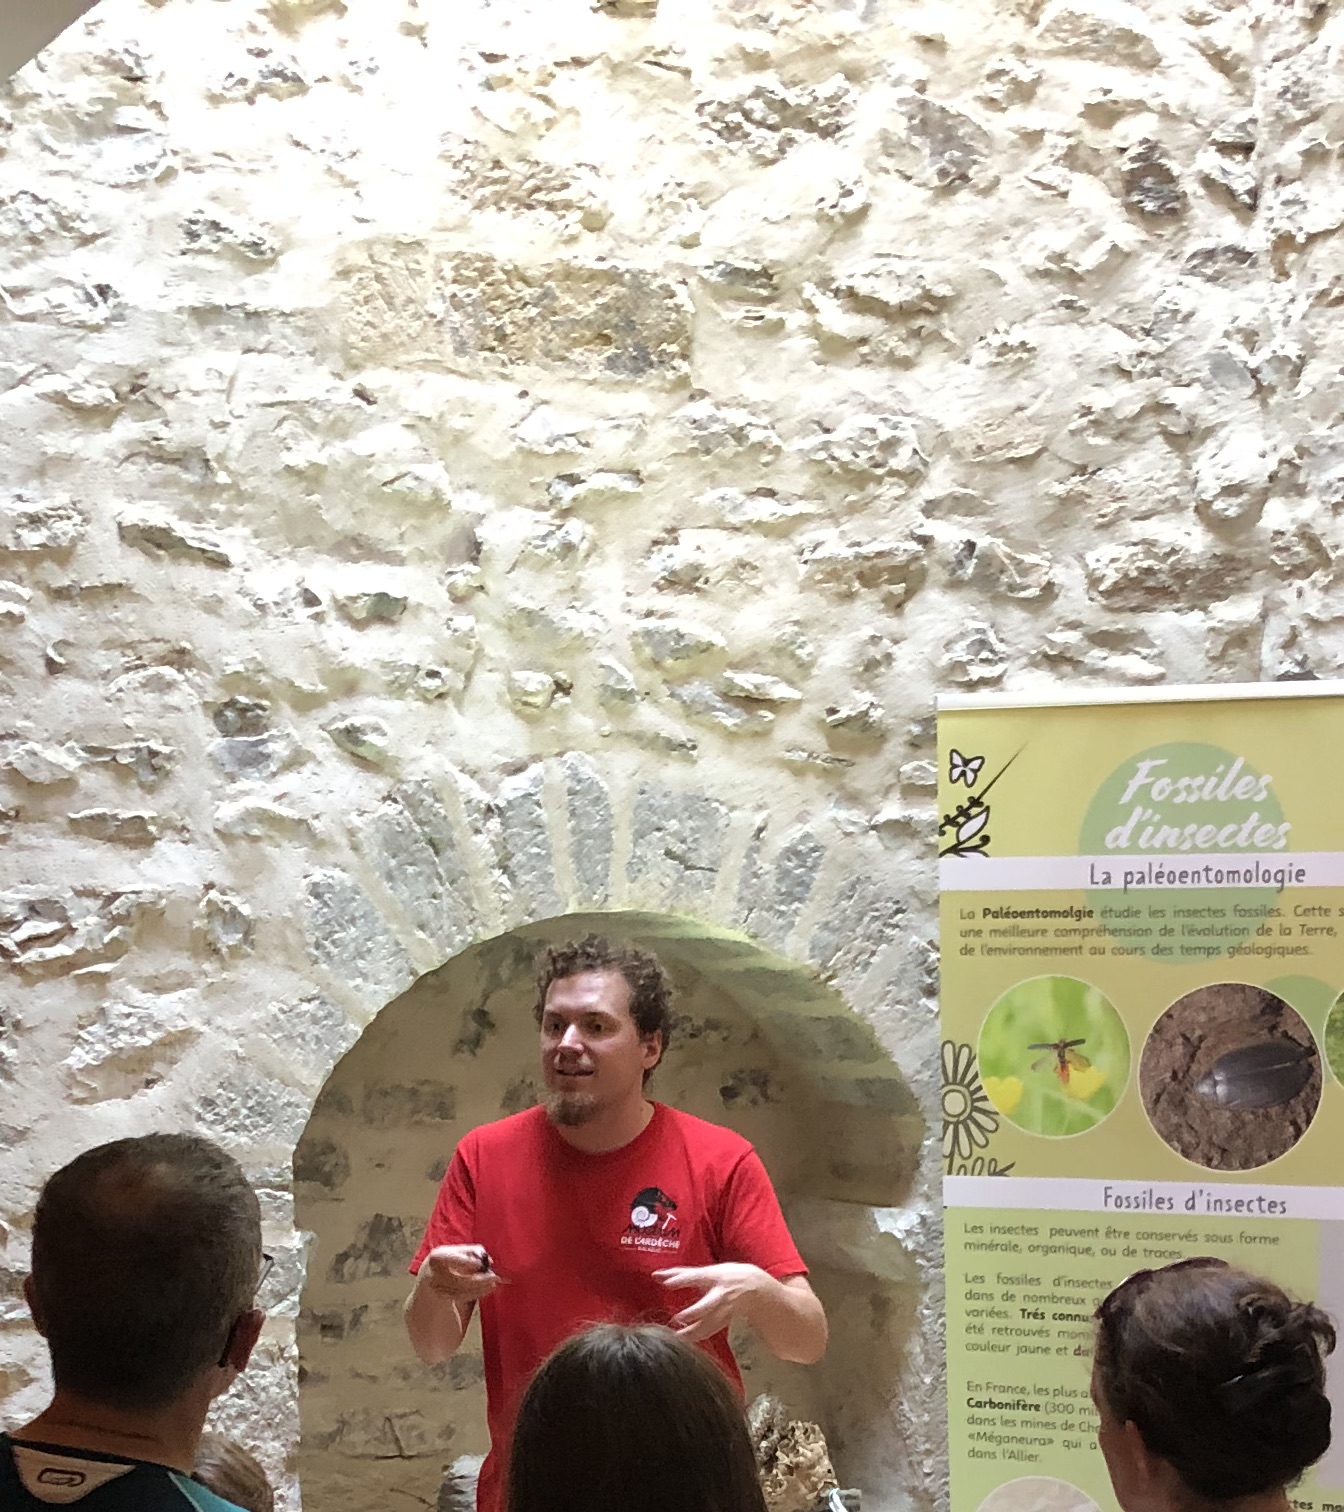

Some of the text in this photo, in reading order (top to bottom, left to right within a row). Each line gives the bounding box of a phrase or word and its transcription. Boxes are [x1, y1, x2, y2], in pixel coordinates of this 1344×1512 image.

[1118, 756, 1273, 805] Fossiles
[1105, 805, 1292, 850] d'insectes
[1089, 860, 1306, 894] La paléoentomologie
[959, 908, 975, 920] La
[1100, 907, 1142, 919] étudie
[1148, 907, 1166, 919] les
[1173, 906, 1226, 919] insectes
[1233, 904, 1285, 918] fossiles.
[1293, 904, 1332, 917] Cette
[959, 927, 984, 938] une
[989, 924, 1049, 938] meilleure
[1054, 924, 1153, 940] compréhension
[1159, 924, 1175, 937] de
[1181, 924, 1250, 937] l'évolution
[1256, 924, 1272, 937] de
[1279, 924, 1292, 937] la
[1299, 923, 1338, 938] Terre,
[959, 943, 1312, 959] de l'environnement au cours des temps géologiques.
[1103, 1186, 1287, 1215] Fossiles d'insectes
[620, 1236, 633, 1245] DE
[964, 1223, 1280, 1246] Les insectes peuvent être conservés sous forme
[963, 1240, 1023, 1254] minérale,
[1027, 1243, 1096, 1257] organique,
[1100, 1248, 1117, 1257] ou
[1122, 1245, 1138, 1257] de
[964, 1271, 1113, 1290] Les fossiles d'insectes
[964, 1289, 994, 1301] dans
[1001, 1290, 1016, 1302] de
[1022, 1292, 1087, 1306] nombreux
[964, 1305, 1012, 1319] variées.
[1019, 1307, 1046, 1320] Trés
[964, 1323, 985, 1335] été
[991, 1326, 1051, 1338] retrouvés
[964, 1340, 1012, 1353] couleur
[1015, 1344, 1052, 1357] jaune
[1055, 1346, 1069, 1356] et
[966, 1380, 983, 1393] En
[985, 1382, 1030, 1397] France,
[1033, 1383, 1050, 1396] les
[1052, 1384, 1078, 1399] plus
[966, 1396, 1041, 1412] Carbonifère
[1044, 1400, 1075, 1415] (300
[966, 1413, 997, 1426] dans
[1000, 1415, 1017, 1428] les
[1020, 1418, 1057, 1430] mines
[1060, 1419, 1076, 1432] de
[967, 1431, 1055, 1447] «Méganeura»
[1062, 1437, 1082, 1451] qui
[967, 1447, 1042, 1463] dans l'Allier.
